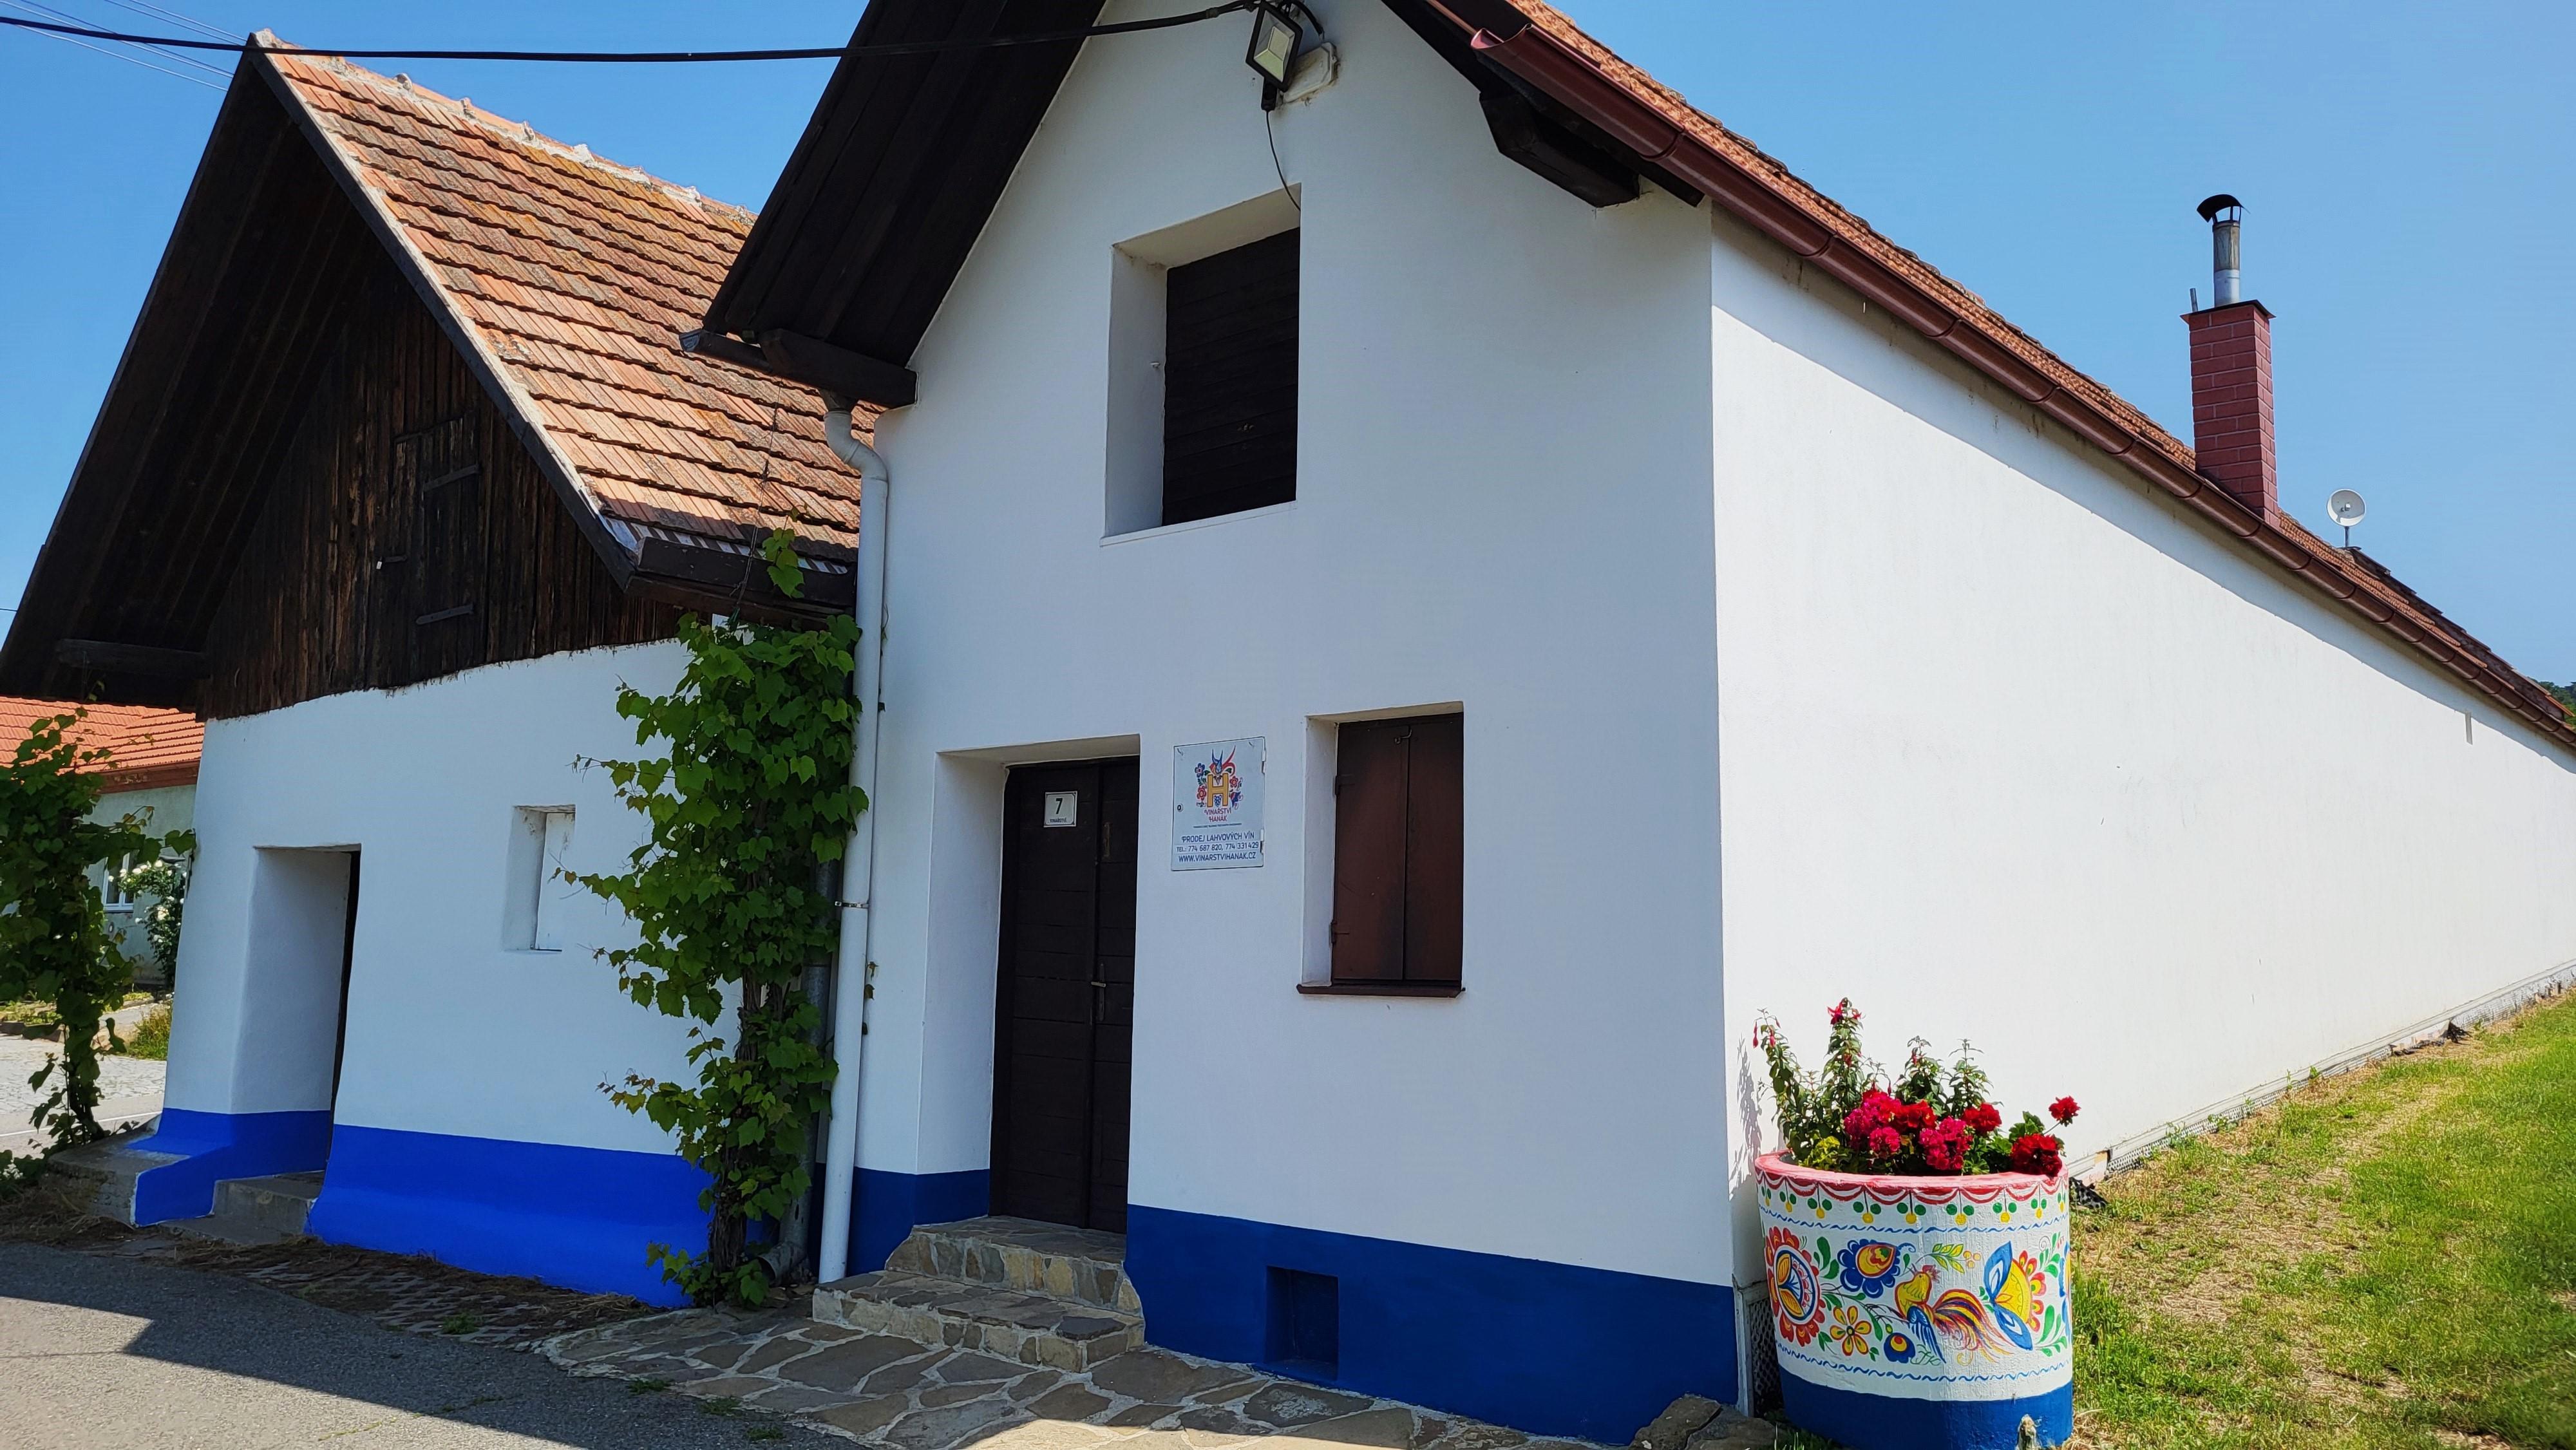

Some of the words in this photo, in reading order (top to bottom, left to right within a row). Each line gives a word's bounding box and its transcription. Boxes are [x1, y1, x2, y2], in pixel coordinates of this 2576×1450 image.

[1206, 773, 1229, 807] H
[1056, 798, 1063, 814] 7
[1182, 834, 1205, 843] PRODEJ
[1207, 831, 1242, 842] LAHVOVÝCH
[1244, 831, 1255, 840] VÍN
[1179, 851, 1256, 863] WWW.VINARSTVIHANAK.CZ
